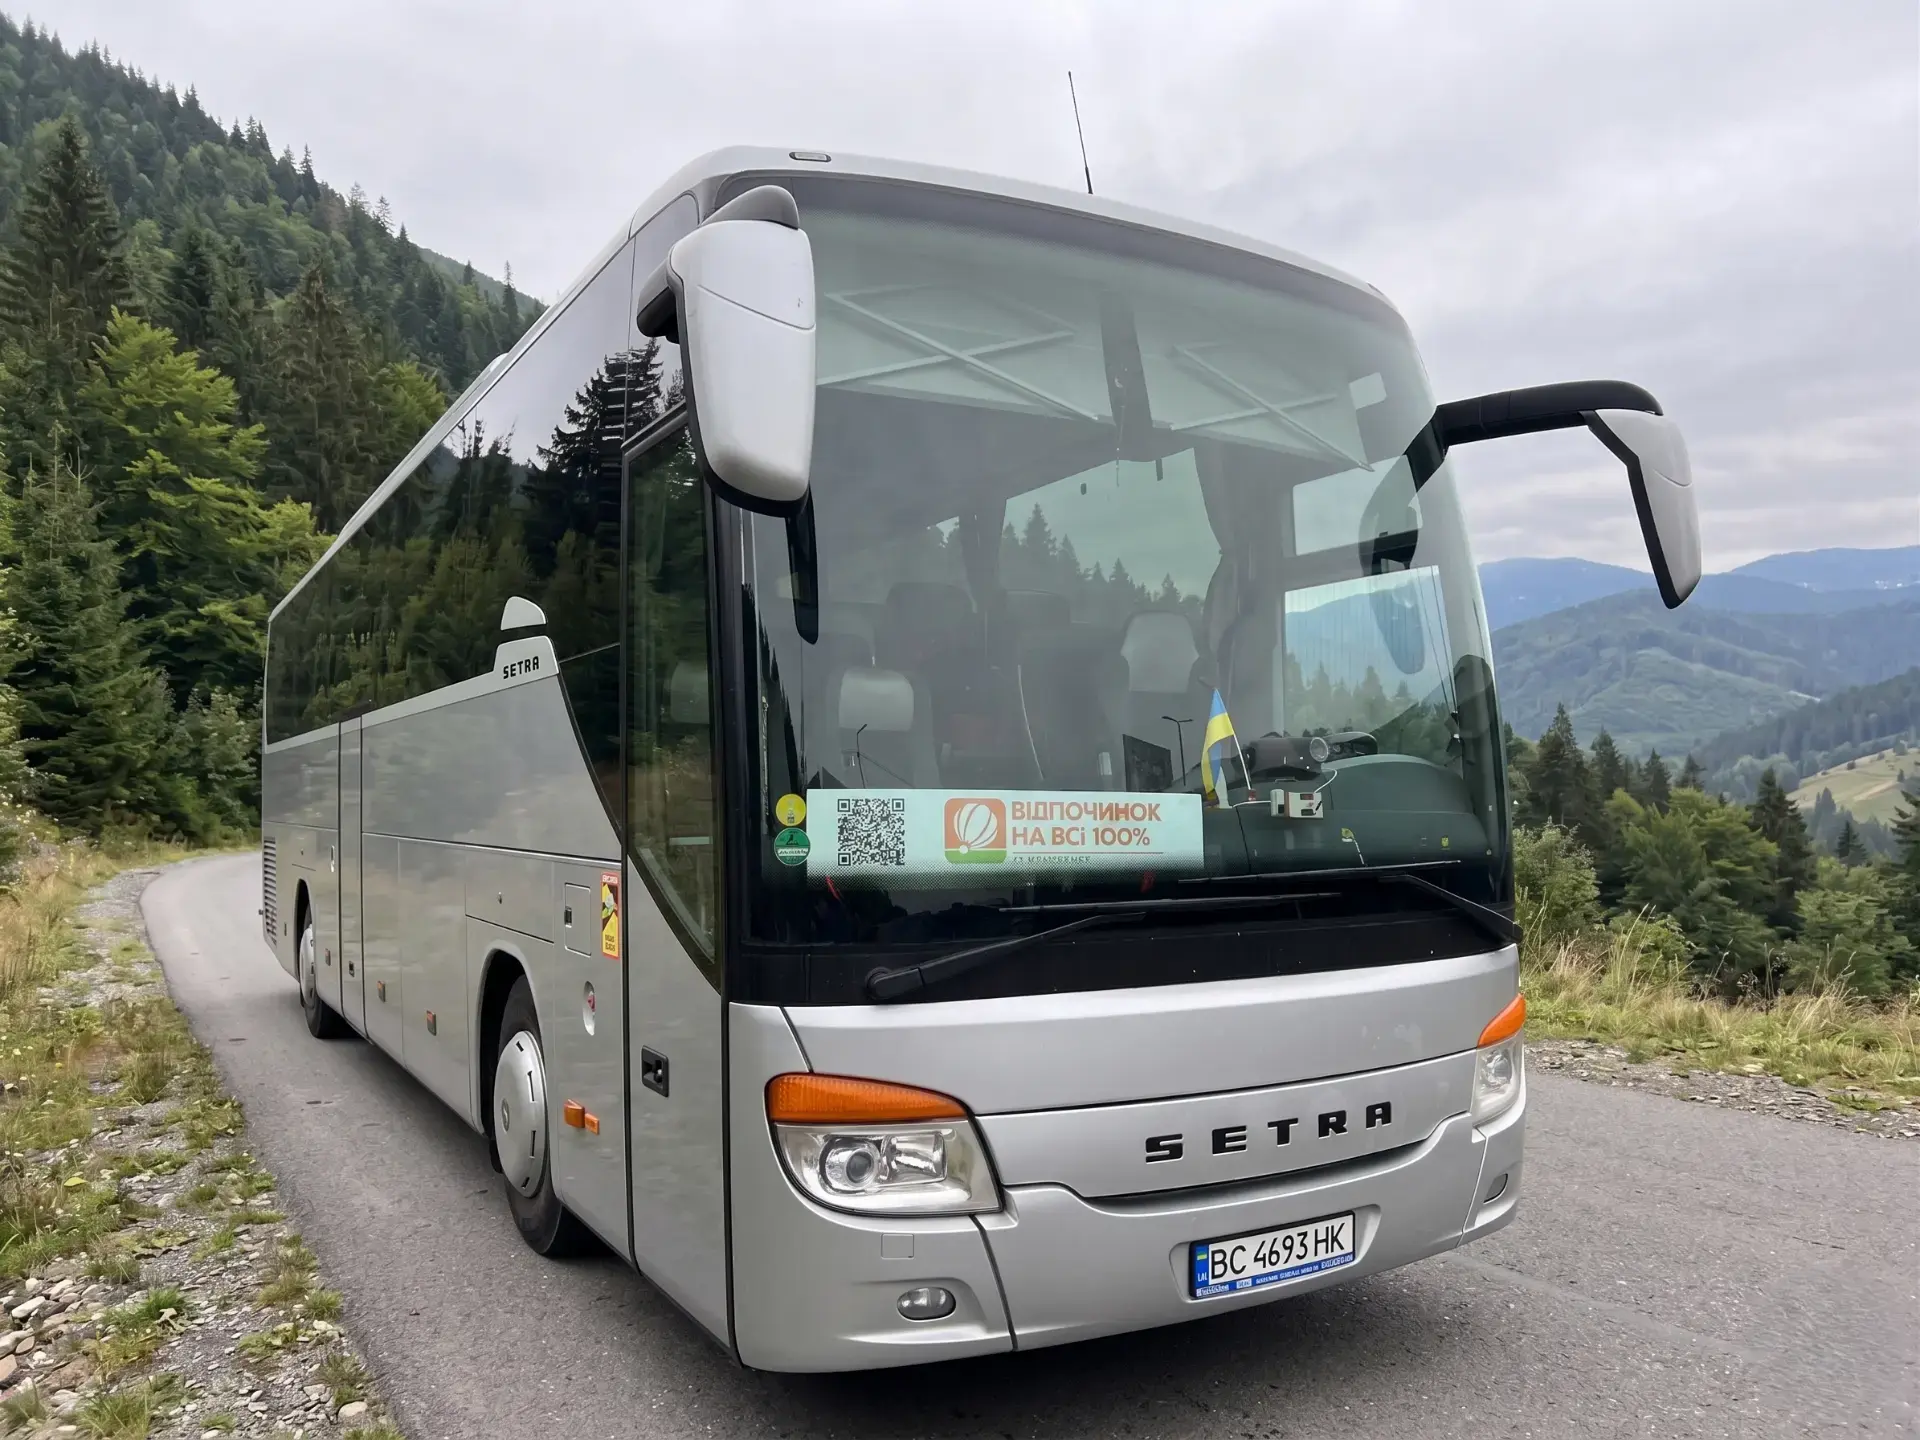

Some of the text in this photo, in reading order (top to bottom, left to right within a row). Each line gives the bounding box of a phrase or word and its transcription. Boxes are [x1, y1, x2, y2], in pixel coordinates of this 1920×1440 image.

[503, 656, 540, 680] SETRA
[1011, 801, 1162, 822] ВІДПОЧИНОК
[1012, 827, 1046, 846] НА
[1092, 827, 1151, 847] 100%
[1145, 1101, 1393, 1164] SETRA
[1211, 1245, 1247, 1280] BC
[1253, 1231, 1309, 1269] 4693
[1314, 1222, 1346, 1257] HK
